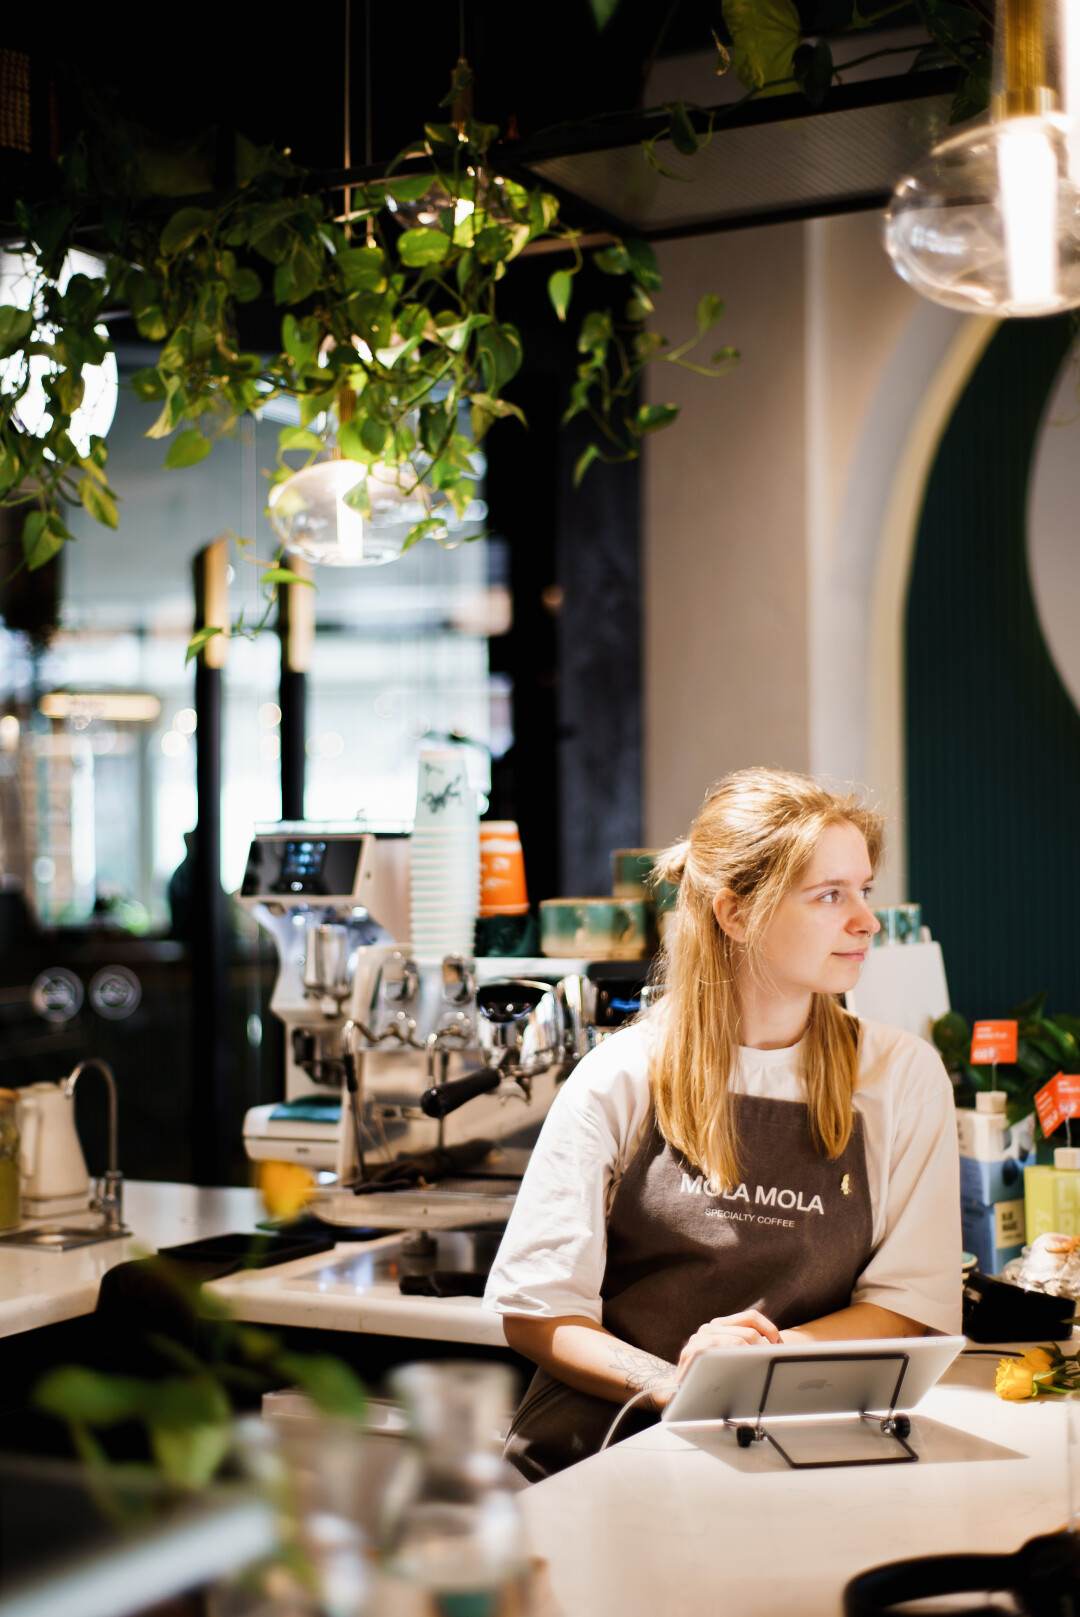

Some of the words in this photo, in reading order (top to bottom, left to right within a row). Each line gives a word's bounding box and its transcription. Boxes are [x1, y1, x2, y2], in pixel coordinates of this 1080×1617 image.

[755, 1185, 825, 1215] MOLA
[704, 1207, 756, 1222] SPECIALTY
[757, 1215, 796, 1228] COFFEE
